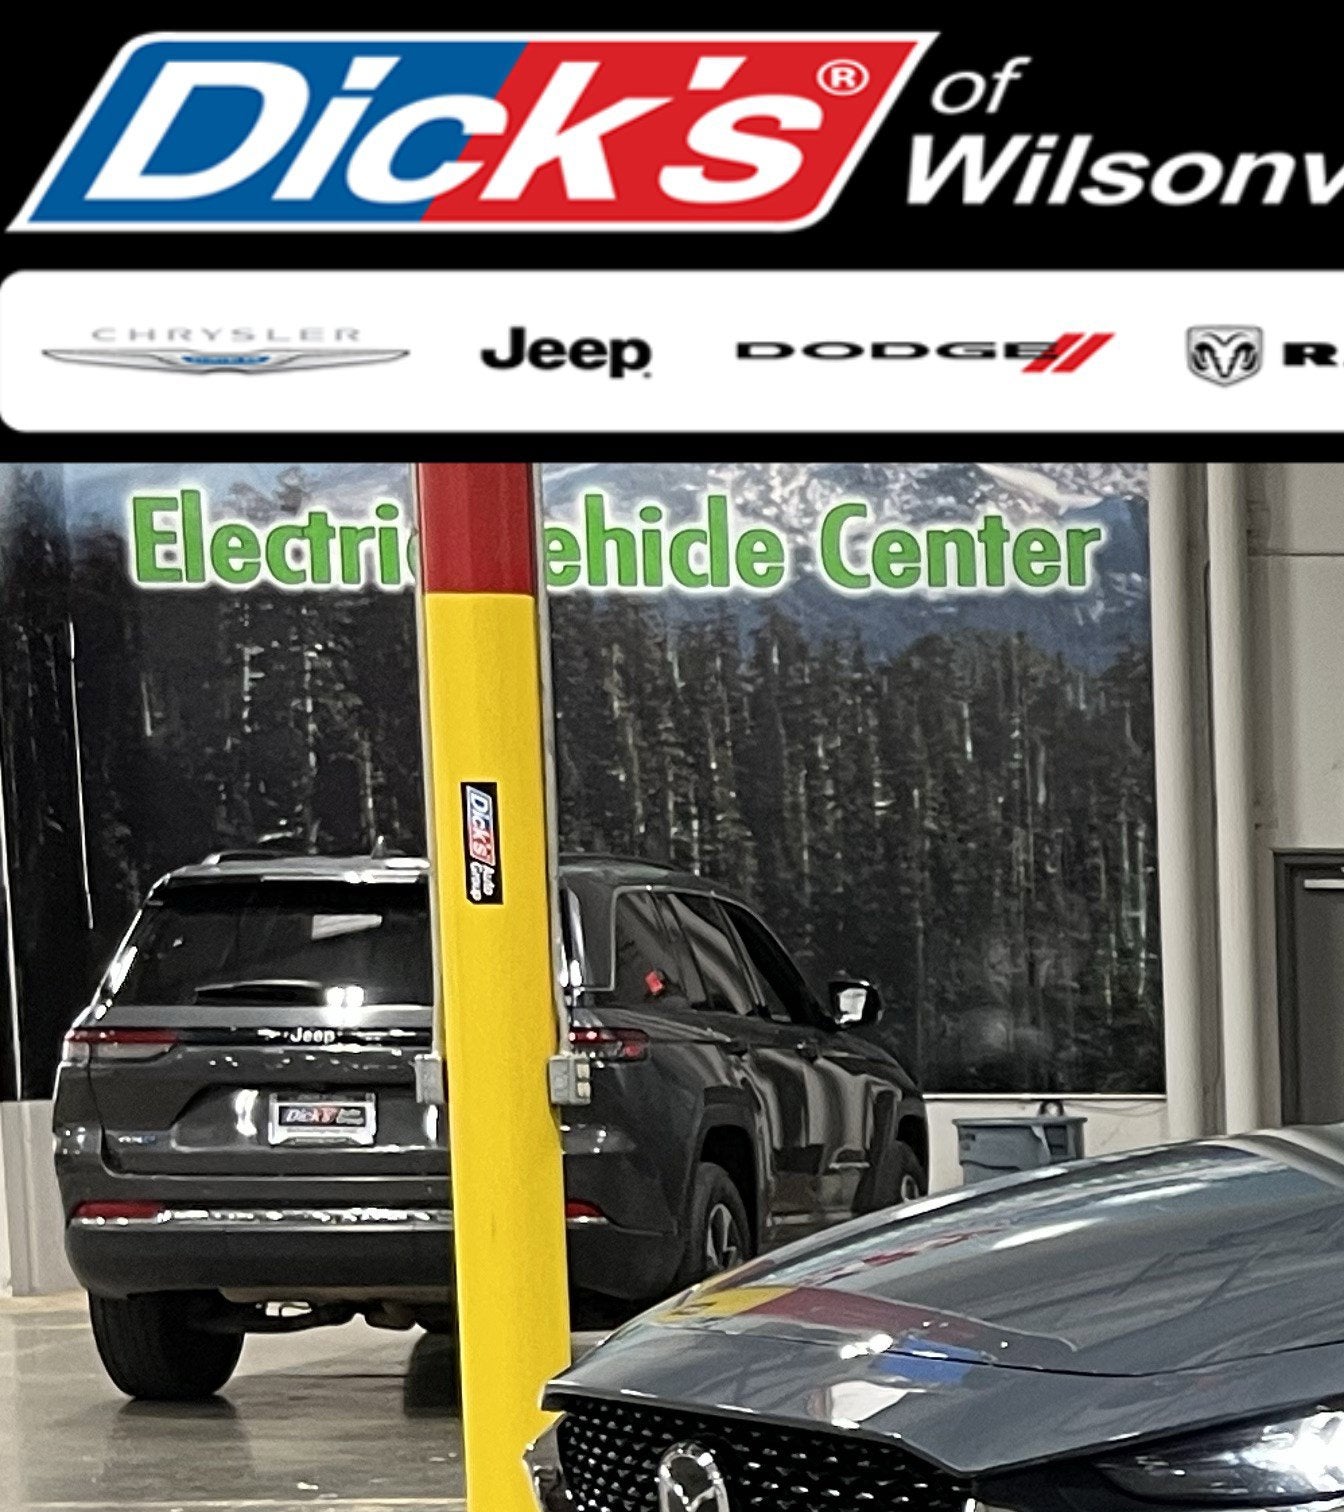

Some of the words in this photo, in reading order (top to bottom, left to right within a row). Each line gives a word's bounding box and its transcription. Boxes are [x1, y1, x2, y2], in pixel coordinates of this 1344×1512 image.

[132, 489, 419, 586] Electri
[544, 493, 785, 588] ehicle
[820, 502, 1101, 590] Center
[290, 1027, 336, 1045] Jeep
